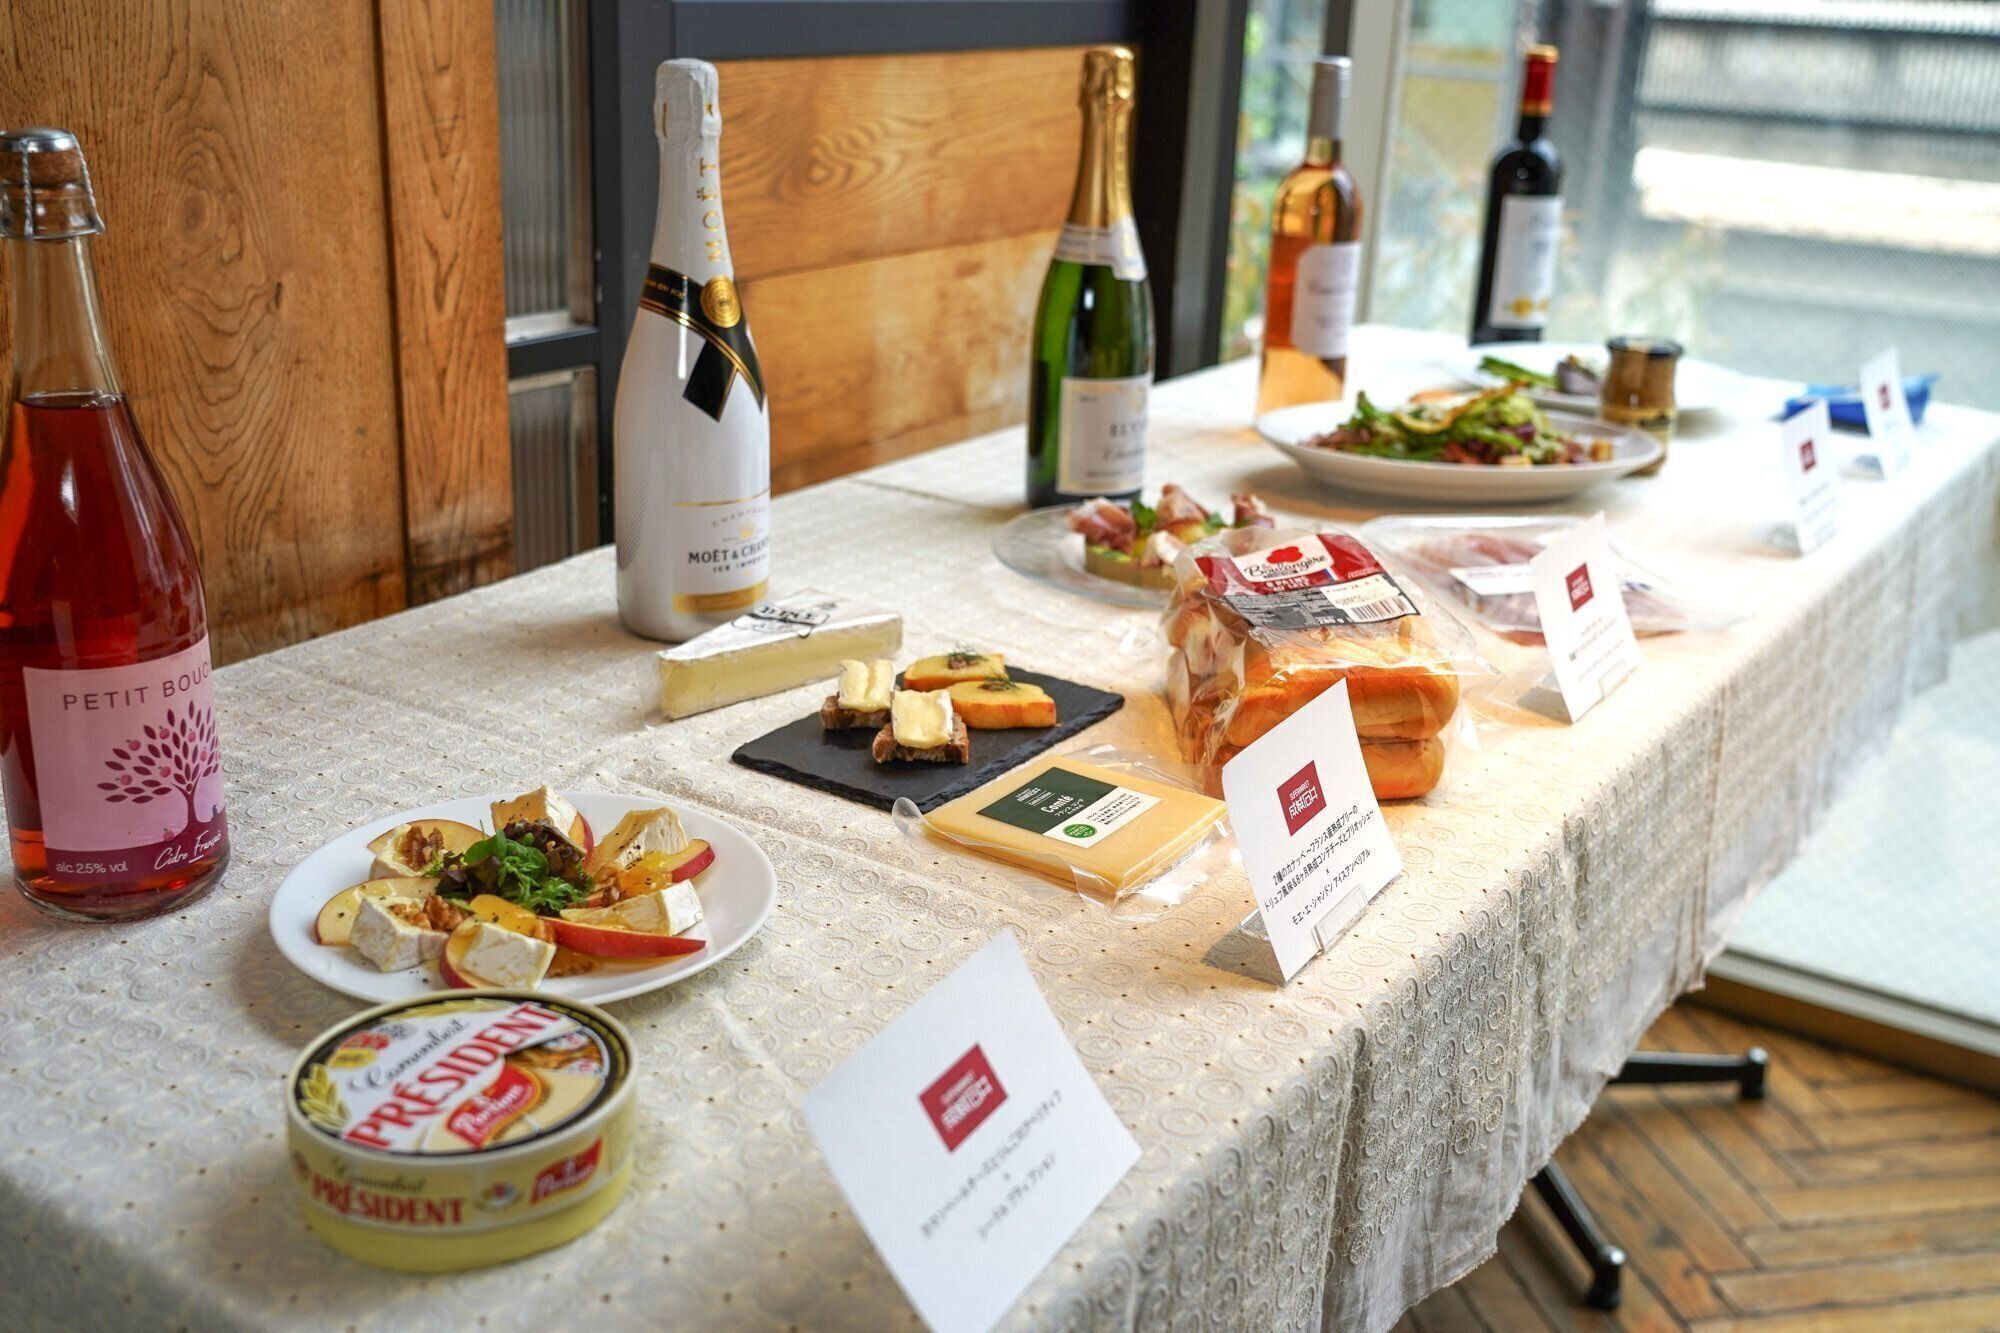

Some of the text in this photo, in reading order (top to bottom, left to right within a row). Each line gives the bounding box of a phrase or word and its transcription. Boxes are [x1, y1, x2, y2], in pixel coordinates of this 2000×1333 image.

[689, 548, 729, 564] MOËT
[1244, 555, 1326, 577] Boulangère
[63, 661, 211, 711] PETIT BOUC
[1040, 795, 1074, 813] Comté
[154, 845, 189, 870] Cidre
[341, 1003, 560, 1148] PRÉSIDENT
[311, 1173, 467, 1227] PRÉSIDENT
